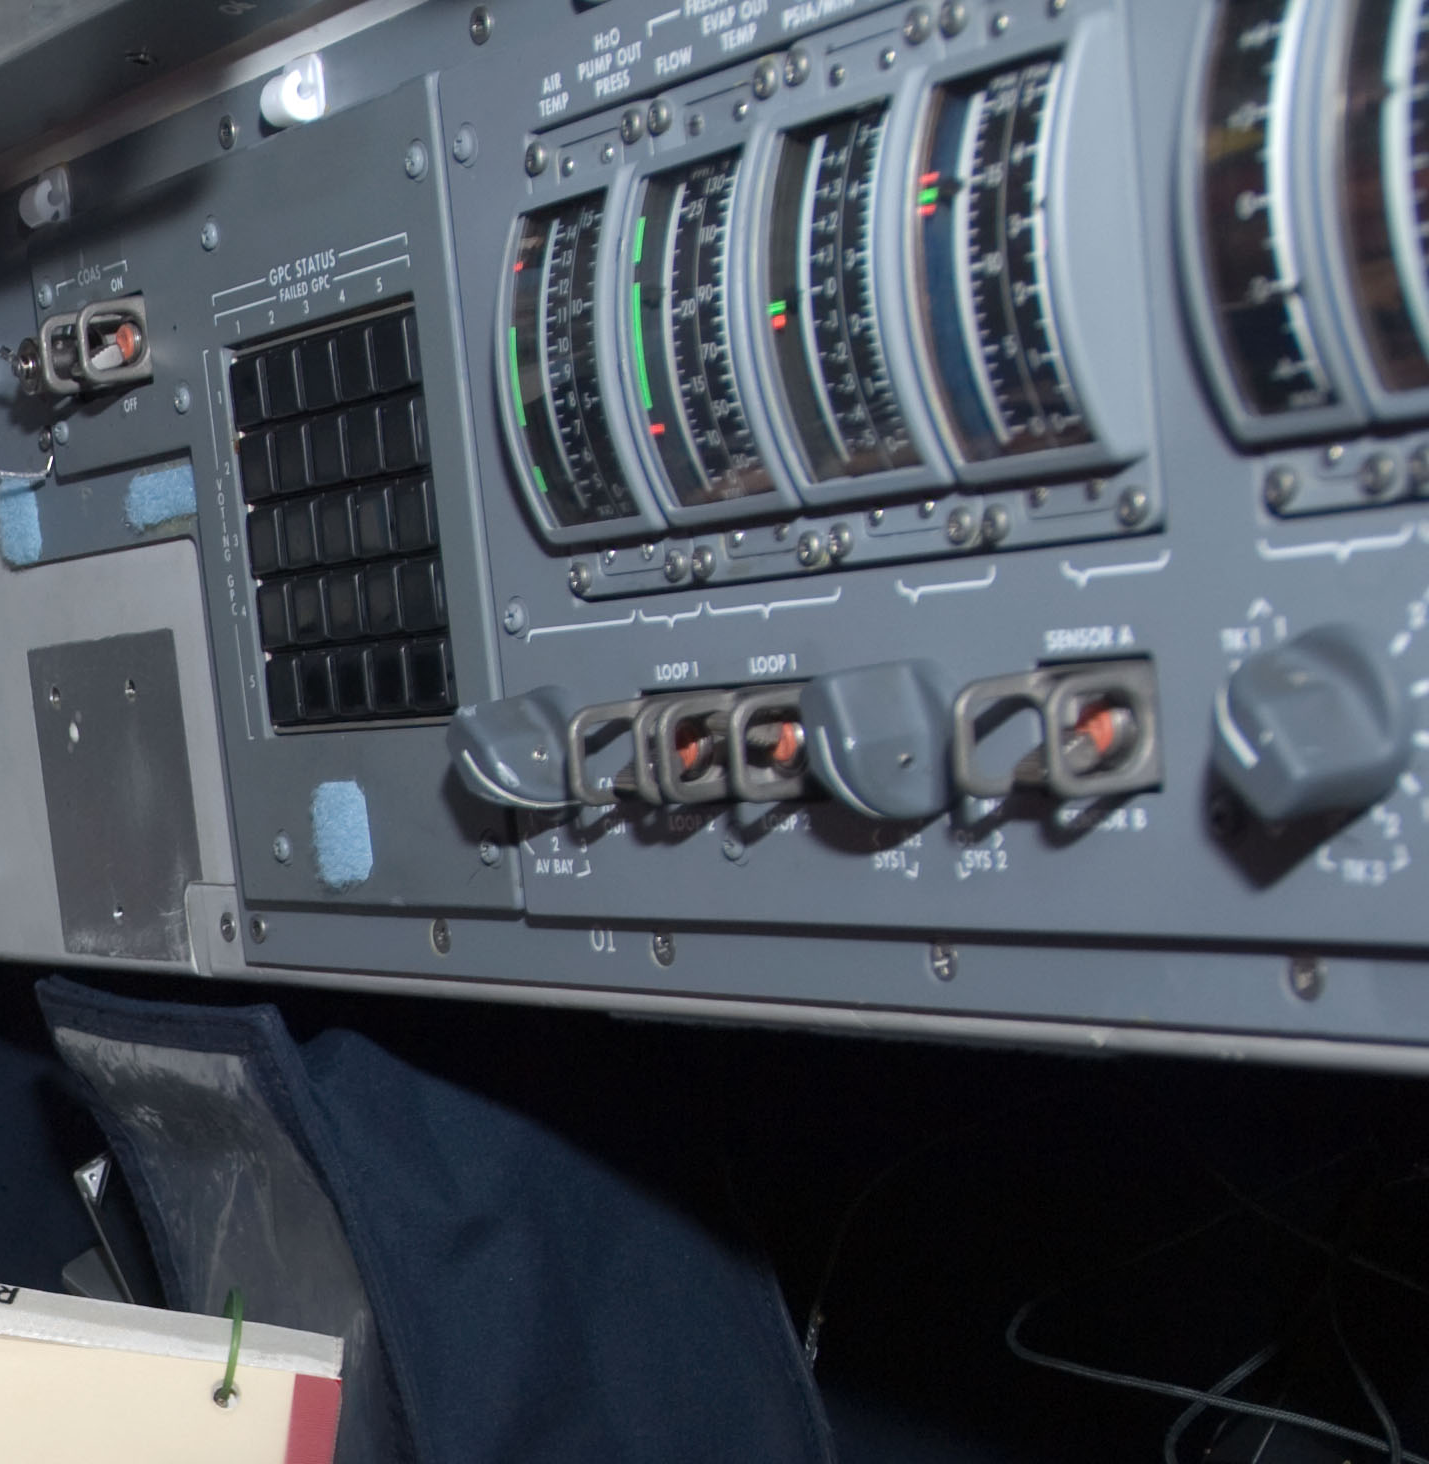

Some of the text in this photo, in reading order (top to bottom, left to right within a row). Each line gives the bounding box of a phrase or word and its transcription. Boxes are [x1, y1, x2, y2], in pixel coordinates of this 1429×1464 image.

[701, 7, 737, 35] EVAP
[721, 23, 758, 51] TEMP
[577, 41, 642, 81] PUMP OUT
[654, 46, 693, 76] FLOW
[542, 73, 562, 95] AIR
[595, 70, 631, 97] PRESS
[539, 93, 570, 118] TEMP
[77, 264, 101, 287] COAS
[269, 249, 336, 286] GPC STATUS
[110, 278, 124, 293] ON
[279, 277, 331, 303] FAILED GPC
[375, 279, 384, 292] 5
[558, 280, 569, 295] 12
[698, 285, 713, 300] 90
[302, 300, 310, 314] 3
[572, 300, 582, 314] 10
[681, 299, 696, 317] 20
[558, 337, 569, 351] 10
[123, 397, 138, 413] OFF
[216, 478, 238, 616] VOTING GPC
[1044, 625, 1135, 650] SENSOR A
[655, 662, 690, 682] LOOP
[750, 656, 787, 674] LOOP
[536, 859, 574, 876] AV BAY
[965, 851, 991, 869] SYS
